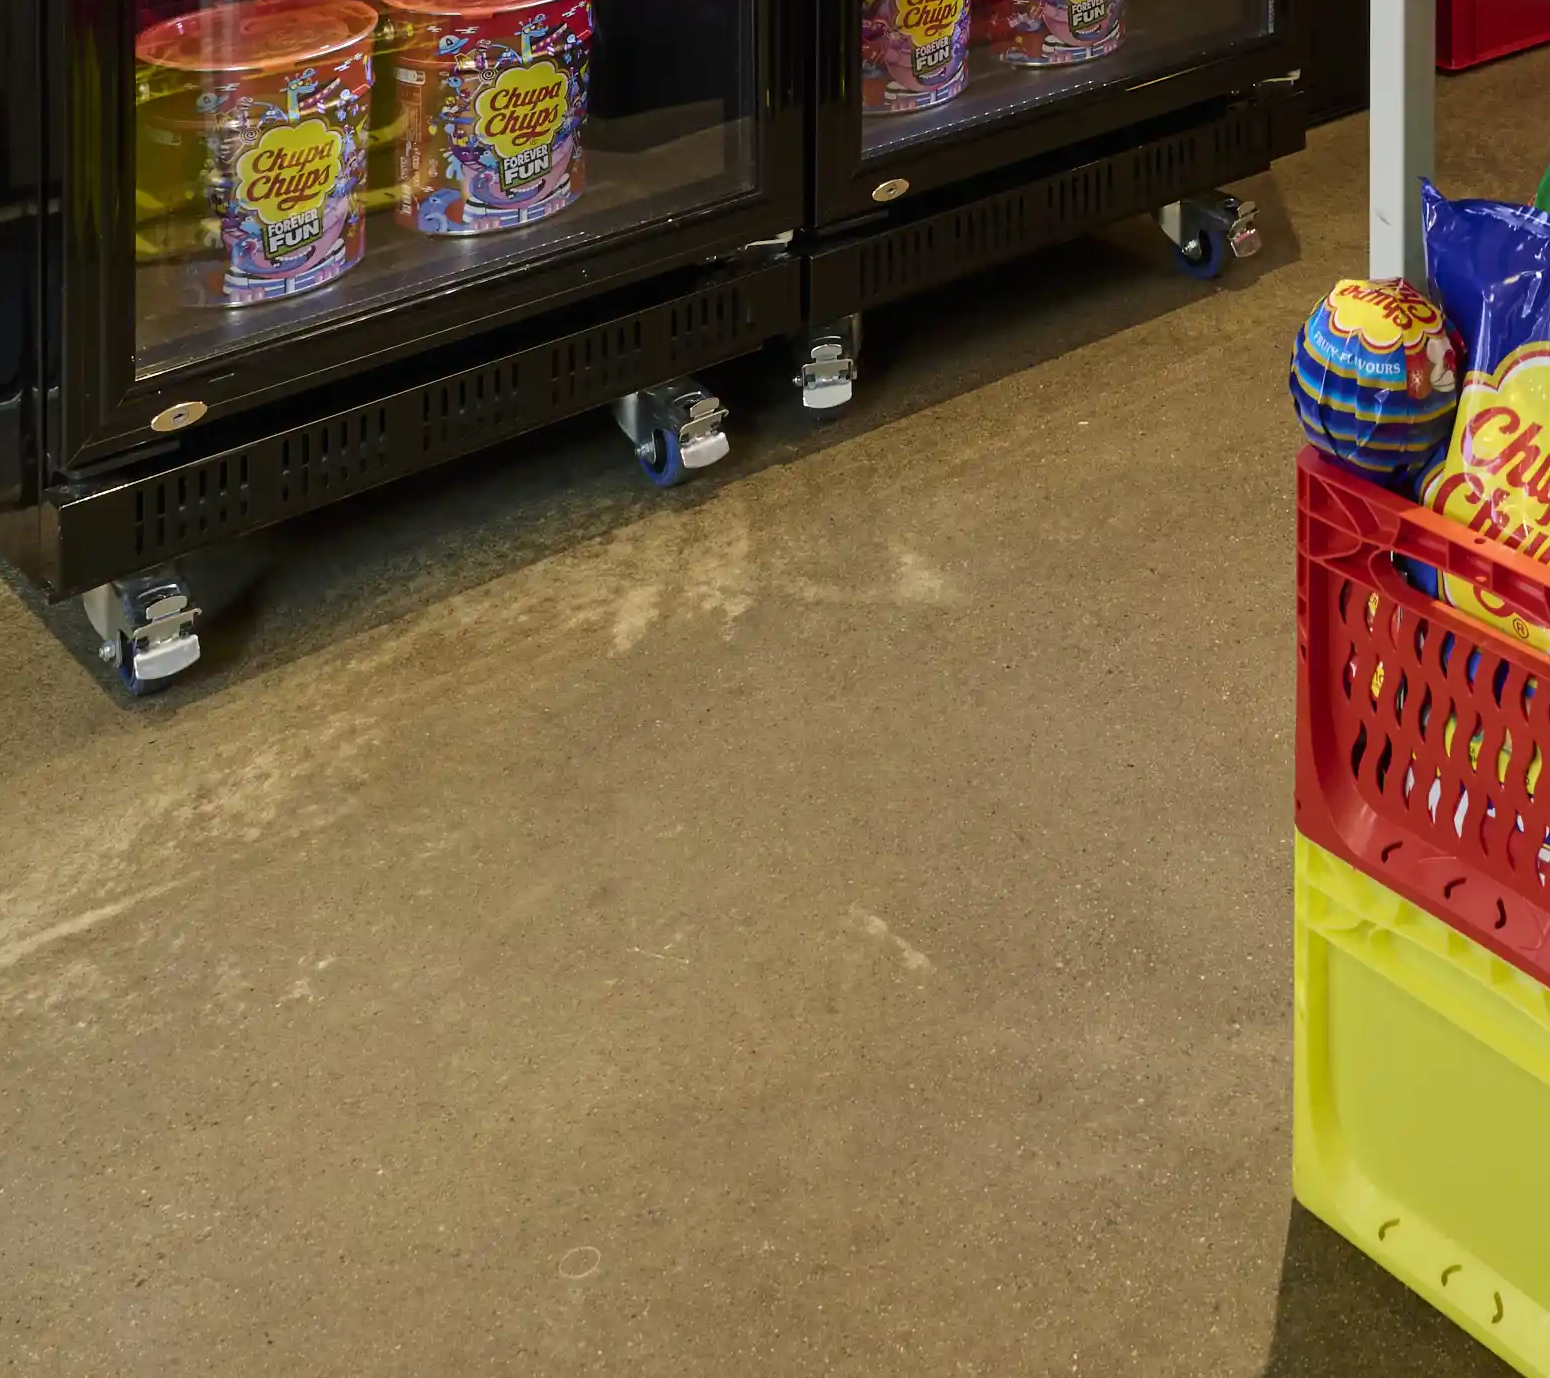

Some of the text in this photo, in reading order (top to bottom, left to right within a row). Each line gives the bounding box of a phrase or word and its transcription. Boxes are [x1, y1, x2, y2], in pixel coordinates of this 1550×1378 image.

[903, 0, 958, 36] Chups
[1072, 3, 1105, 25] FUN
[915, 39, 949, 59] FOREVER
[916, 47, 950, 71] FUN
[489, 80, 563, 112] Chupa
[485, 105, 559, 145] Chups
[251, 140, 332, 172] Chupa
[504, 145, 548, 169] FOREVER
[505, 155, 549, 184] FUN
[247, 160, 332, 210] Chups
[268, 209, 319, 236] FOREVER
[268, 221, 320, 253] FUN
